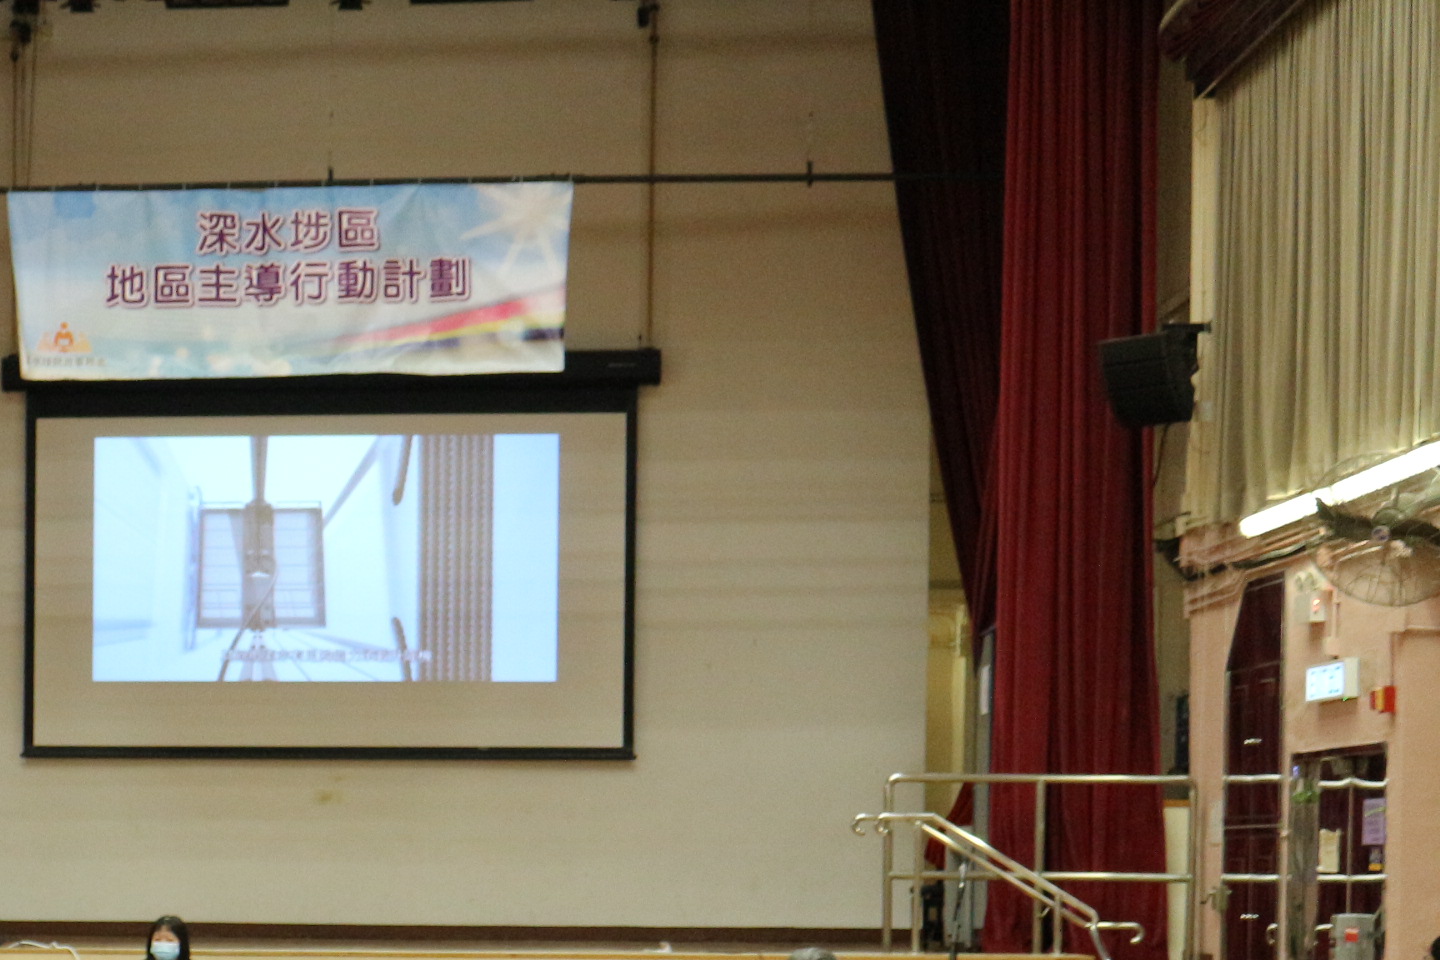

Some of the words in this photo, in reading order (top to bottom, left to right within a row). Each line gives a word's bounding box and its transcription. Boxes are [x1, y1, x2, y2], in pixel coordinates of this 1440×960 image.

[196, 208, 381, 256] 深水埗區
[105, 258, 473, 308] 地區主導行動計劃
